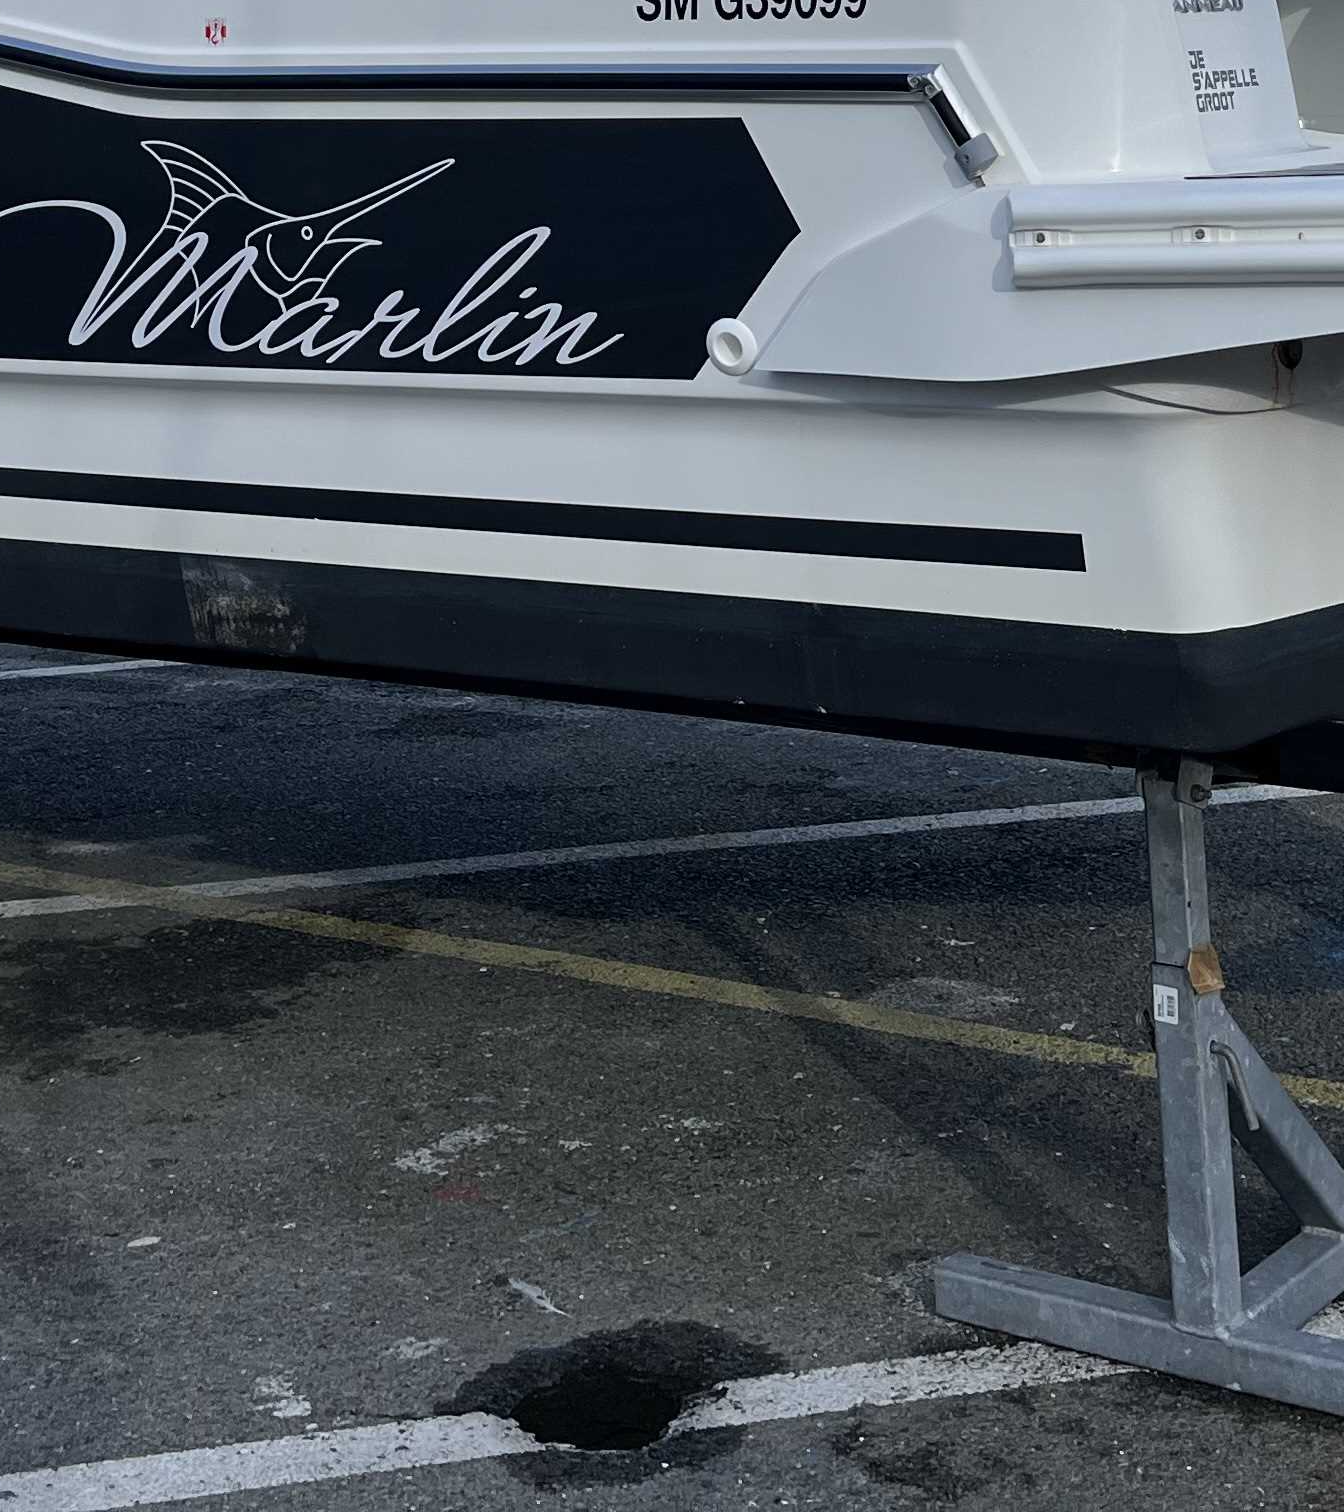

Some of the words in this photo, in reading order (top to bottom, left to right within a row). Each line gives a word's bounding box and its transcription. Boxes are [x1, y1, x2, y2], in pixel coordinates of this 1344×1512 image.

[1188, 50, 1205, 69] JE
[1192, 68, 1259, 91] S'APPELLE
[1196, 91, 1235, 112] GROOT
